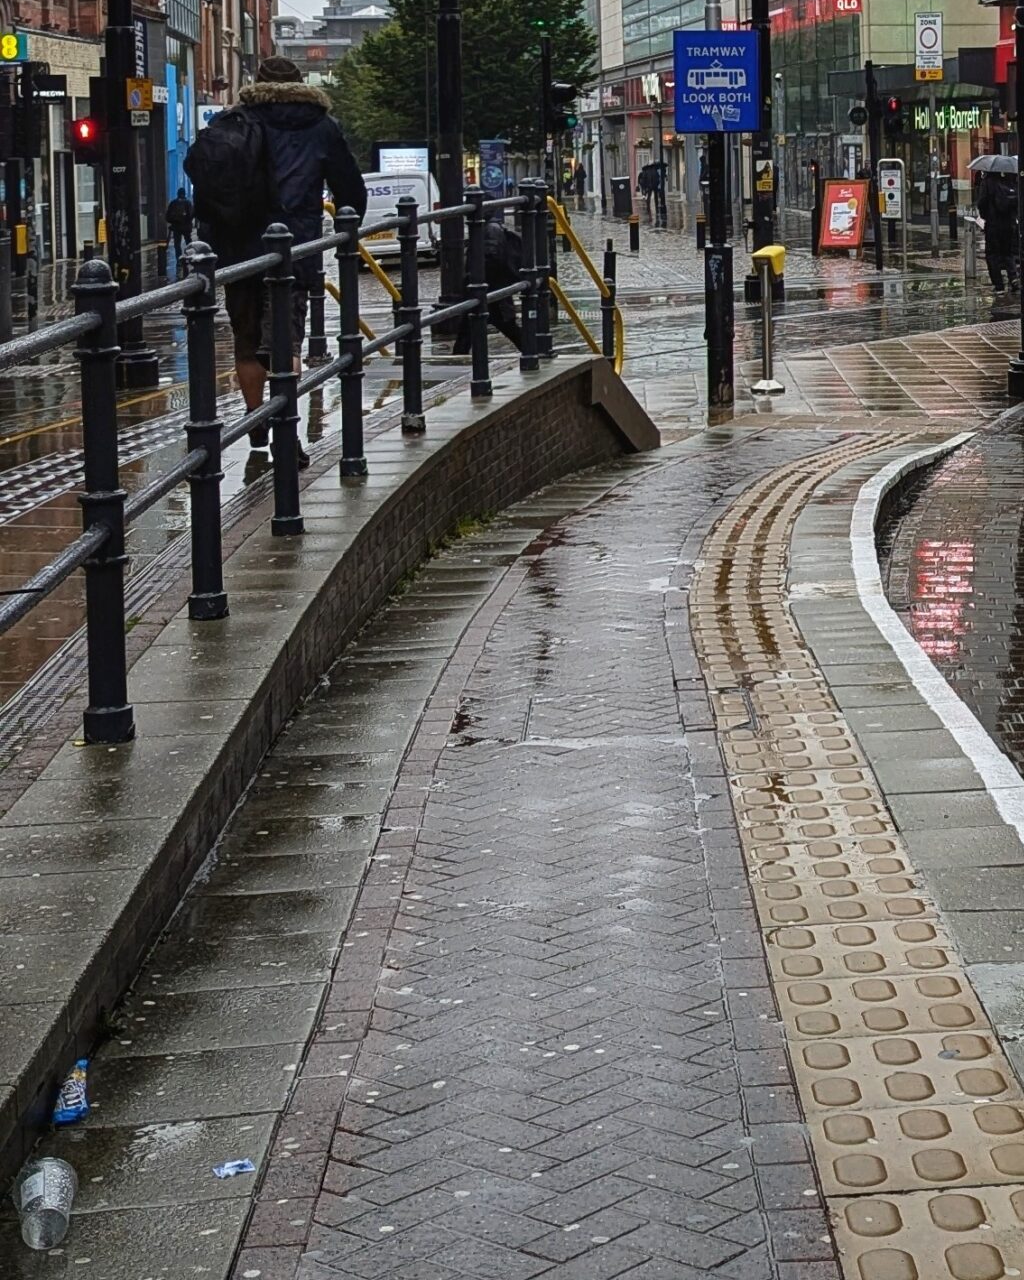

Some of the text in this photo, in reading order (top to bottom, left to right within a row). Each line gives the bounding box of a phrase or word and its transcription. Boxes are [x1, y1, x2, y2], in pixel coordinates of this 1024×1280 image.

[837, 0, 858, 10] QLO
[686, 47, 746, 57] TRAMWAY
[683, 93, 751, 103] LOOK BOTH
[701, 104, 734, 114] WAYS
[914, 106, 944, 129] Hollnd
[950, 105, 980, 129] Barrett
